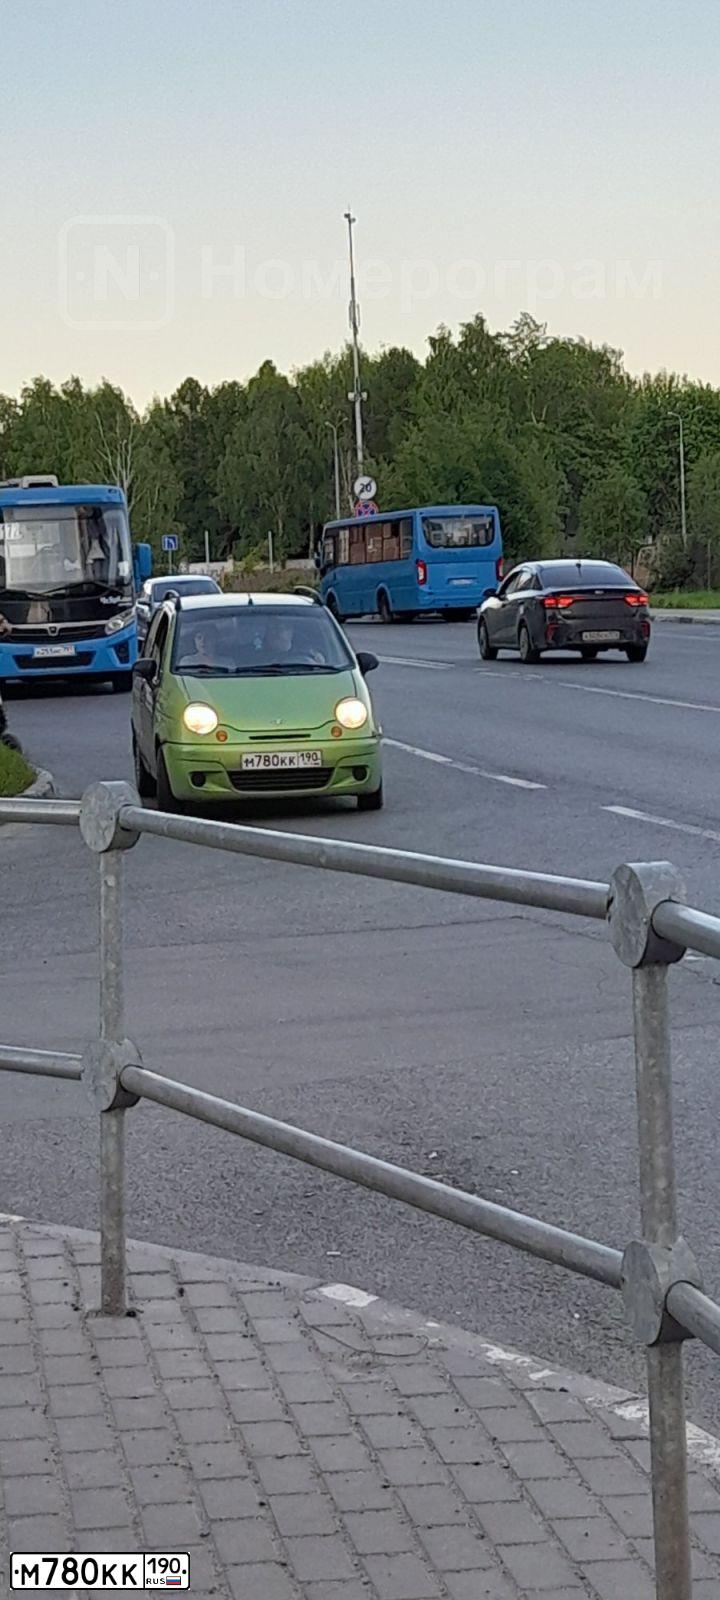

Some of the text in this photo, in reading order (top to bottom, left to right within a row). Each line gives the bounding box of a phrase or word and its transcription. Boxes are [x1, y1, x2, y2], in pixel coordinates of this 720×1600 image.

[360, 482, 372, 493] 20
[244, 752, 318, 768] М780КК 190
